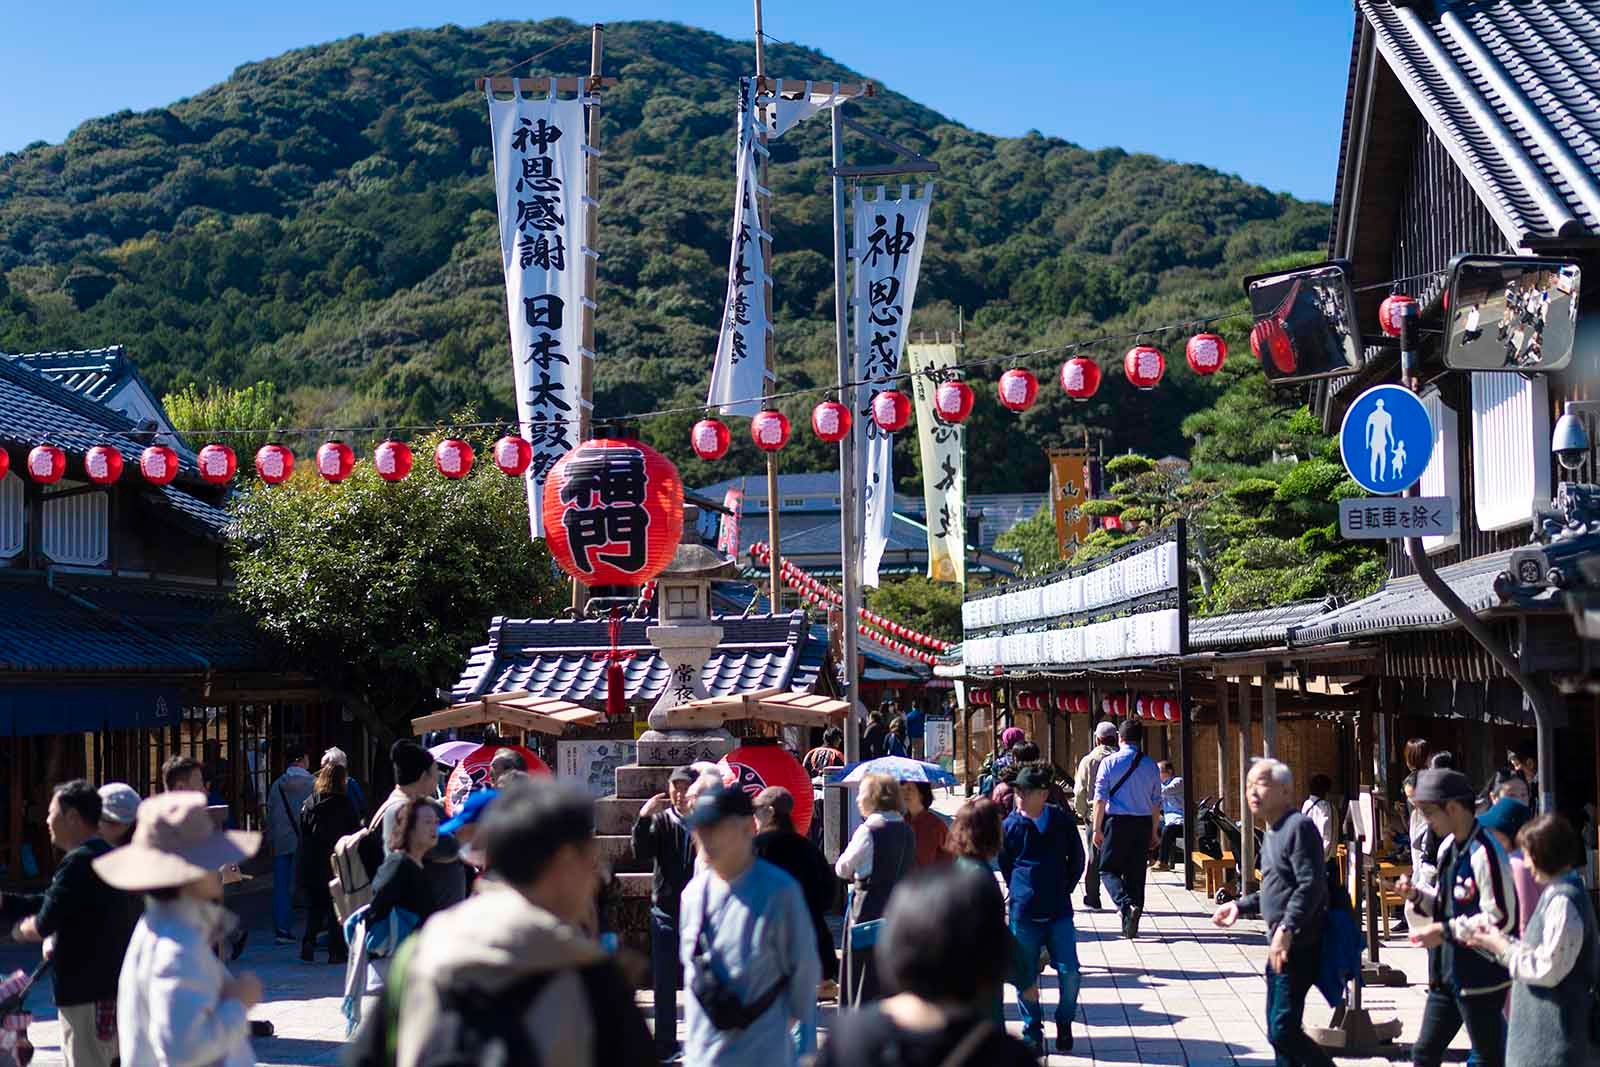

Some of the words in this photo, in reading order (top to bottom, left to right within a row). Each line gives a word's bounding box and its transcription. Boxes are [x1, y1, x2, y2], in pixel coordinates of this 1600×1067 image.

[512, 117, 566, 271] 神恩感謝
[1348, 505, 1442, 530] 自転車を除く
[672, 664, 696, 707] 常夜
